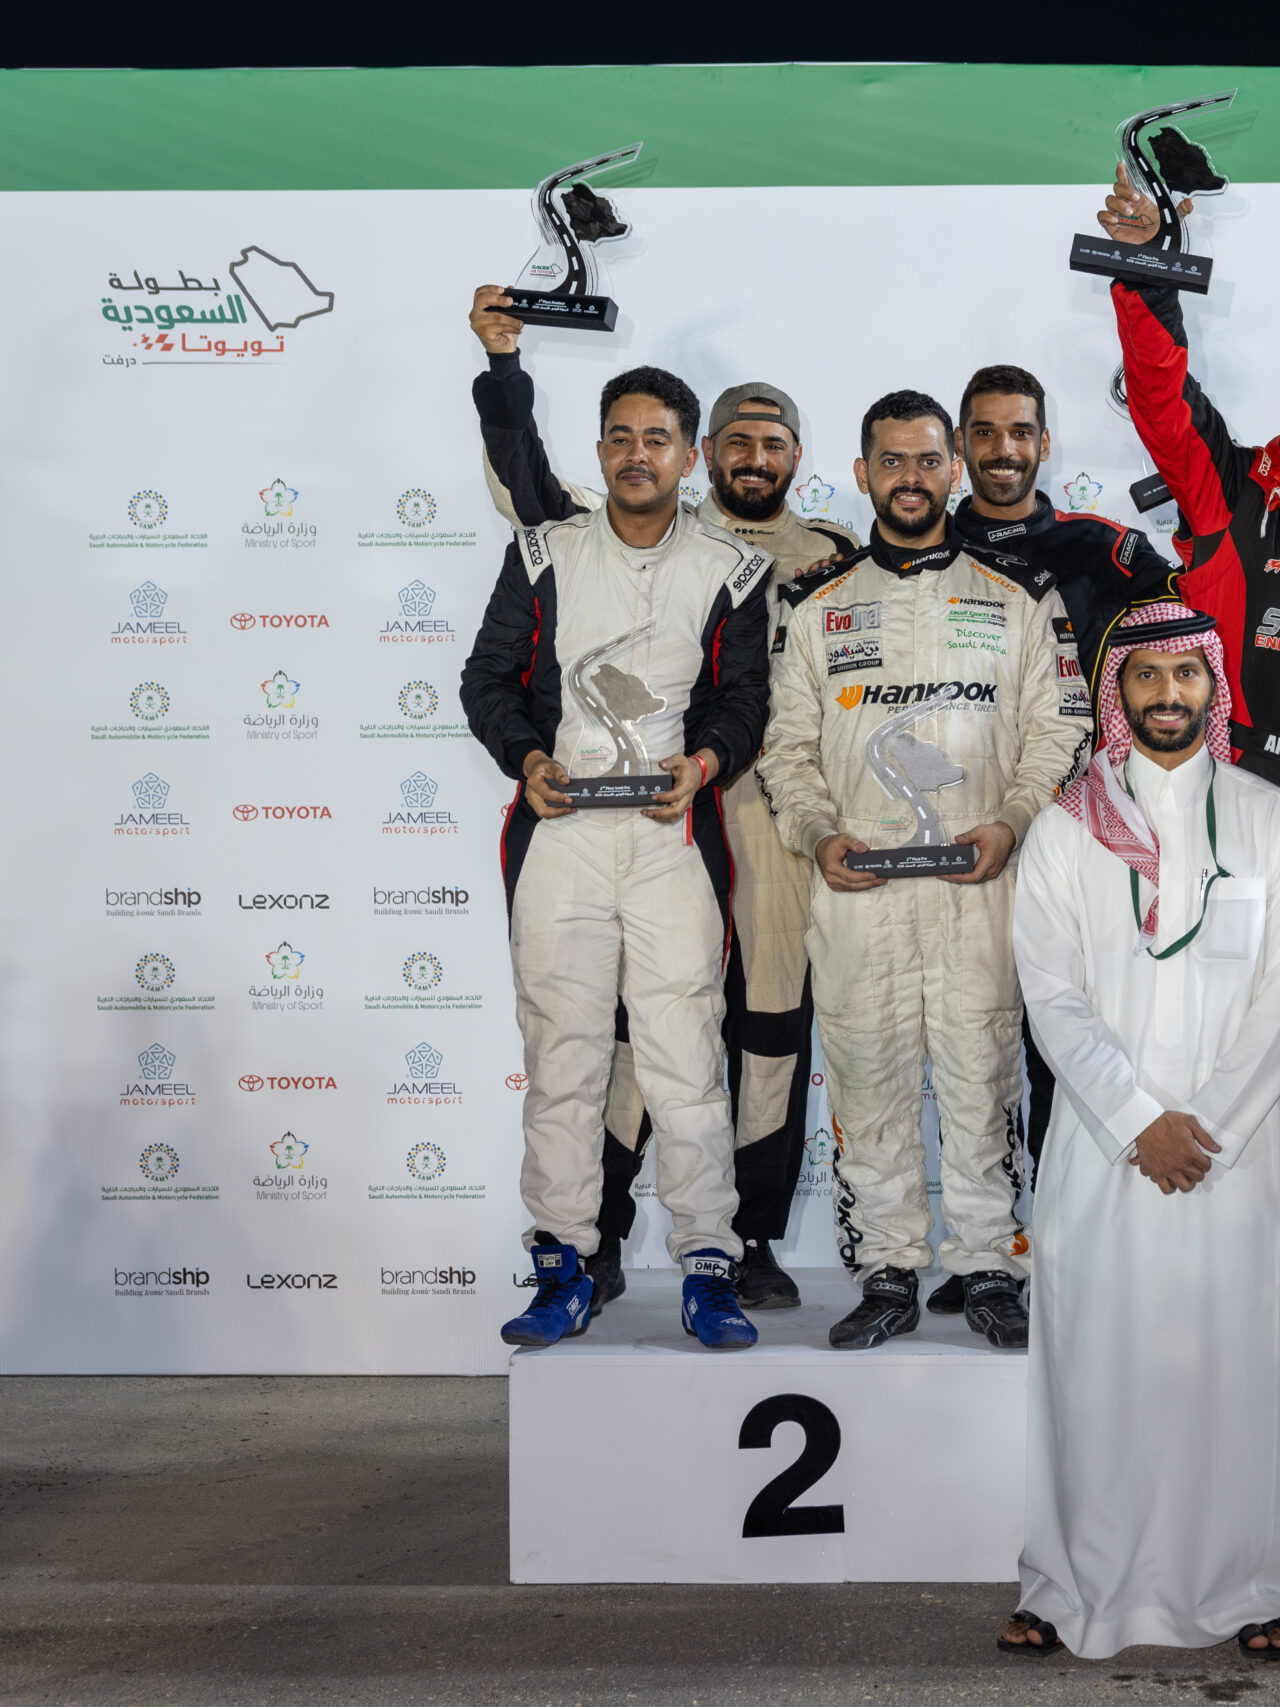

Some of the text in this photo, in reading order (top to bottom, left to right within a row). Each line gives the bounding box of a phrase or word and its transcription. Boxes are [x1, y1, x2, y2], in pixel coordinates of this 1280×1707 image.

[109, 270, 221, 295] بطولة
[102, 294, 248, 331] السعودية
[182, 333, 285, 357] تويوتا
[103, 354, 137, 367] درفت
[241, 522, 317, 536] وزارة الرياضة
[245, 539, 277, 549] Ministry
[292, 539, 316, 549] Sport
[259, 615, 329, 627] TOYOTA
[380, 621, 455, 632] JAMEEL
[111, 622, 187, 633] JAMEEL
[380, 634, 455, 644] motorsport
[955, 628, 1002, 640] Discover
[111, 635, 187, 645] motorsport
[947, 640, 976, 649] Saudi
[244, 714, 318, 728] وزارة الرياضة
[248, 730, 279, 740] Ministry
[294, 730, 318, 740] Sport
[262, 807, 331, 819] TOYOTA
[382, 812, 458, 823] JAMEEL
[114, 814, 190, 825] JAMEEL
[114, 827, 189, 837] motorsport
[382, 825, 457, 835] motorsport
[267, 1077, 337, 1089] TOYOTA
[387, 1083, 463, 1094] JAMEEL
[120, 1084, 196, 1095] JAMEEL
[120, 1097, 195, 1107] motorsport
[387, 1096, 462, 1106] motorsport
[253, 1175, 327, 1189] وزارة الرياضة
[257, 1191, 288, 1201] Ministry
[302, 1191, 327, 1201] Sport
[738, 1394, 845, 1539] 2
